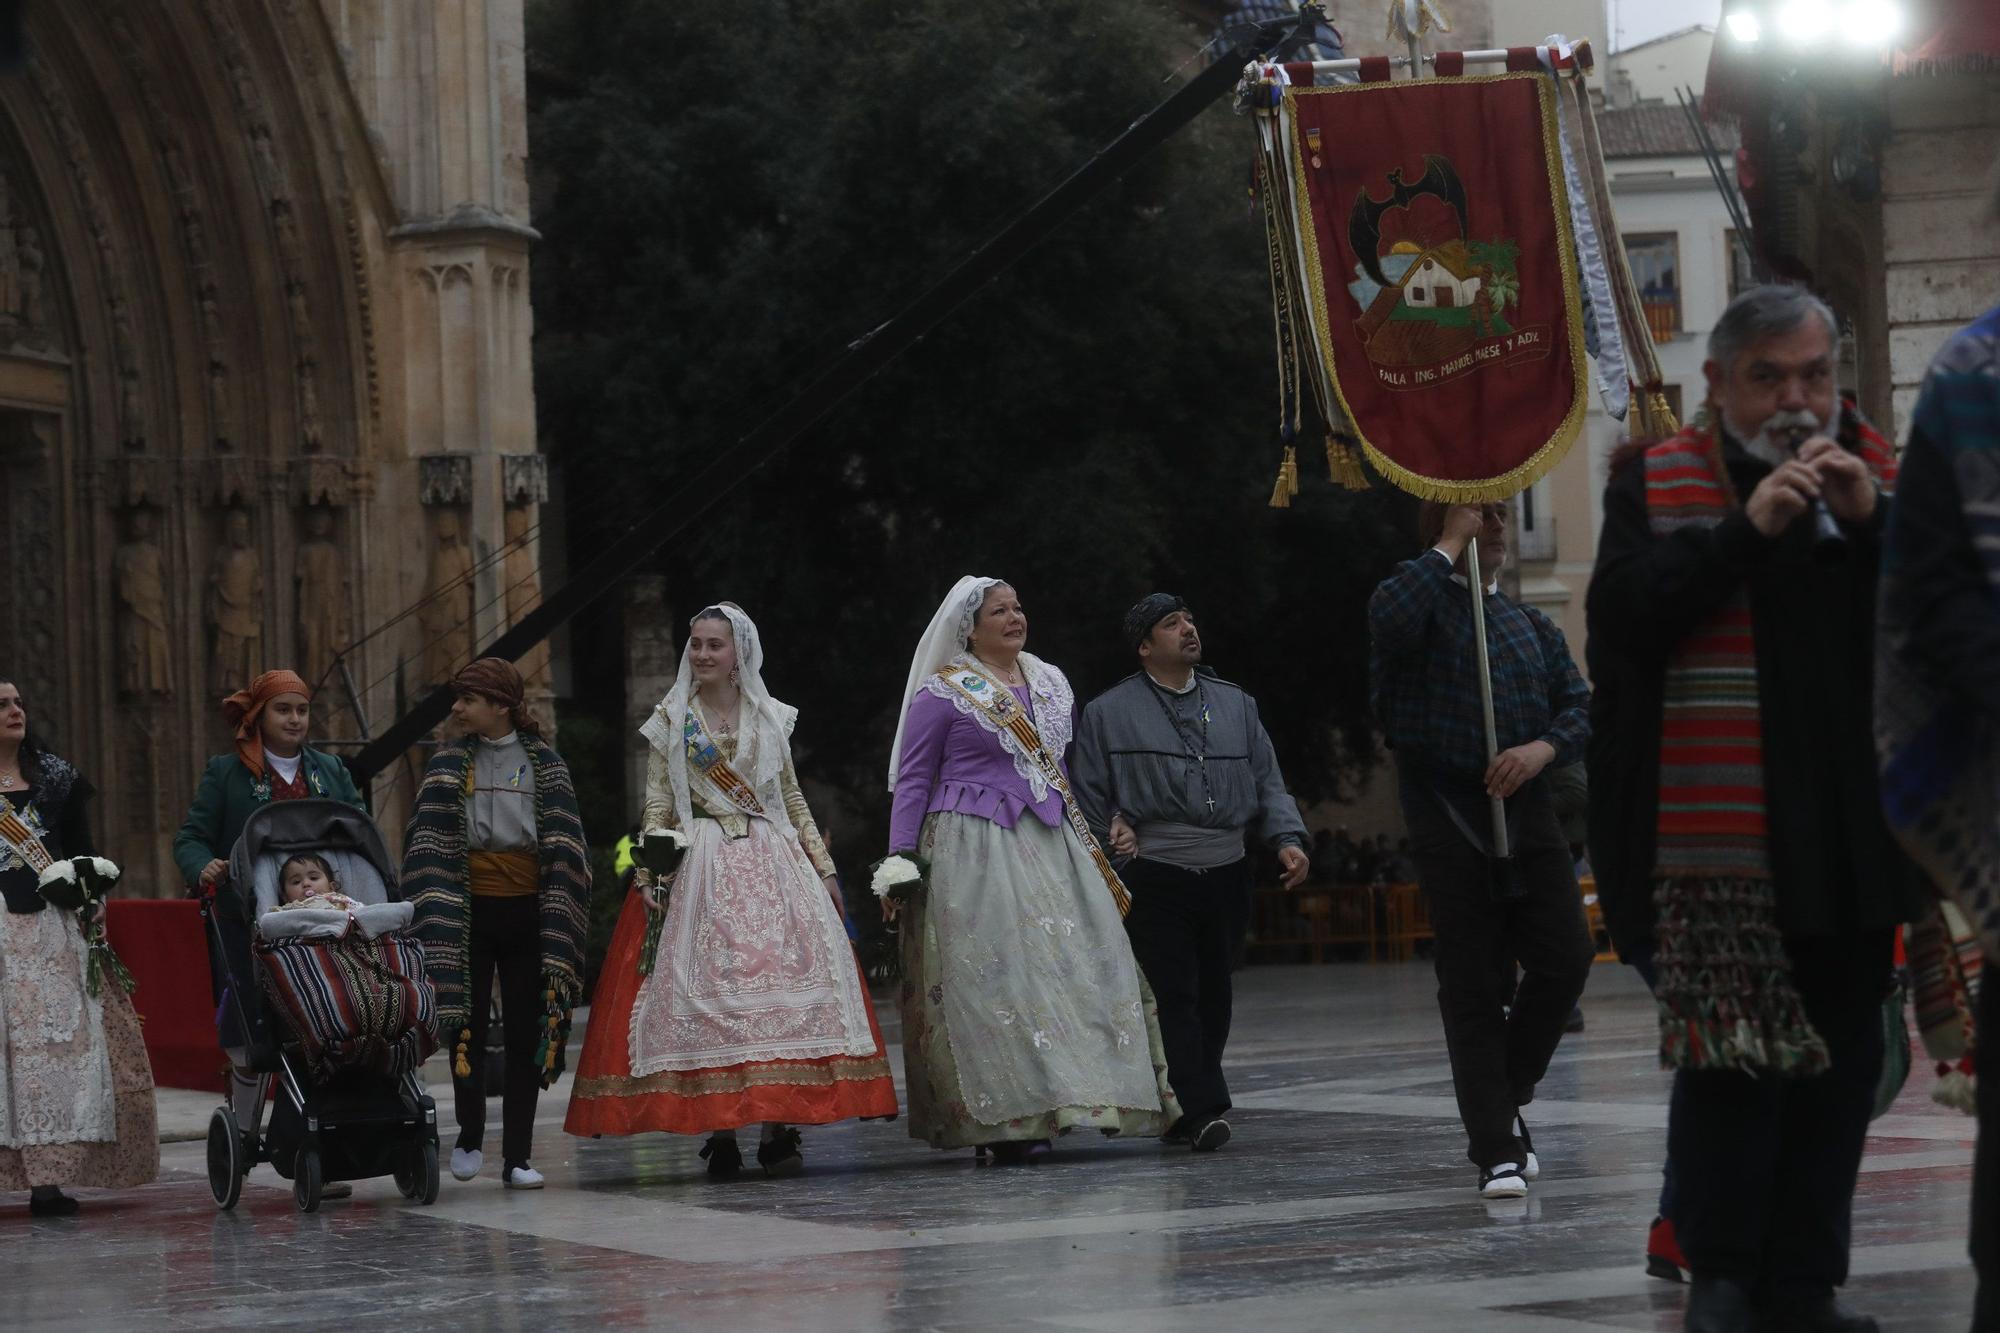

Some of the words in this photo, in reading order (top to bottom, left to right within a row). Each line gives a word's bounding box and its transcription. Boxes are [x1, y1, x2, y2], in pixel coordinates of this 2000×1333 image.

[1379, 369, 1406, 385] FALLA
[1415, 369, 1437, 384] ING.
[1441, 353, 1474, 377] MANUEL
[1475, 344, 1500, 361] MAESE
[1506, 338, 1513, 351] Y
